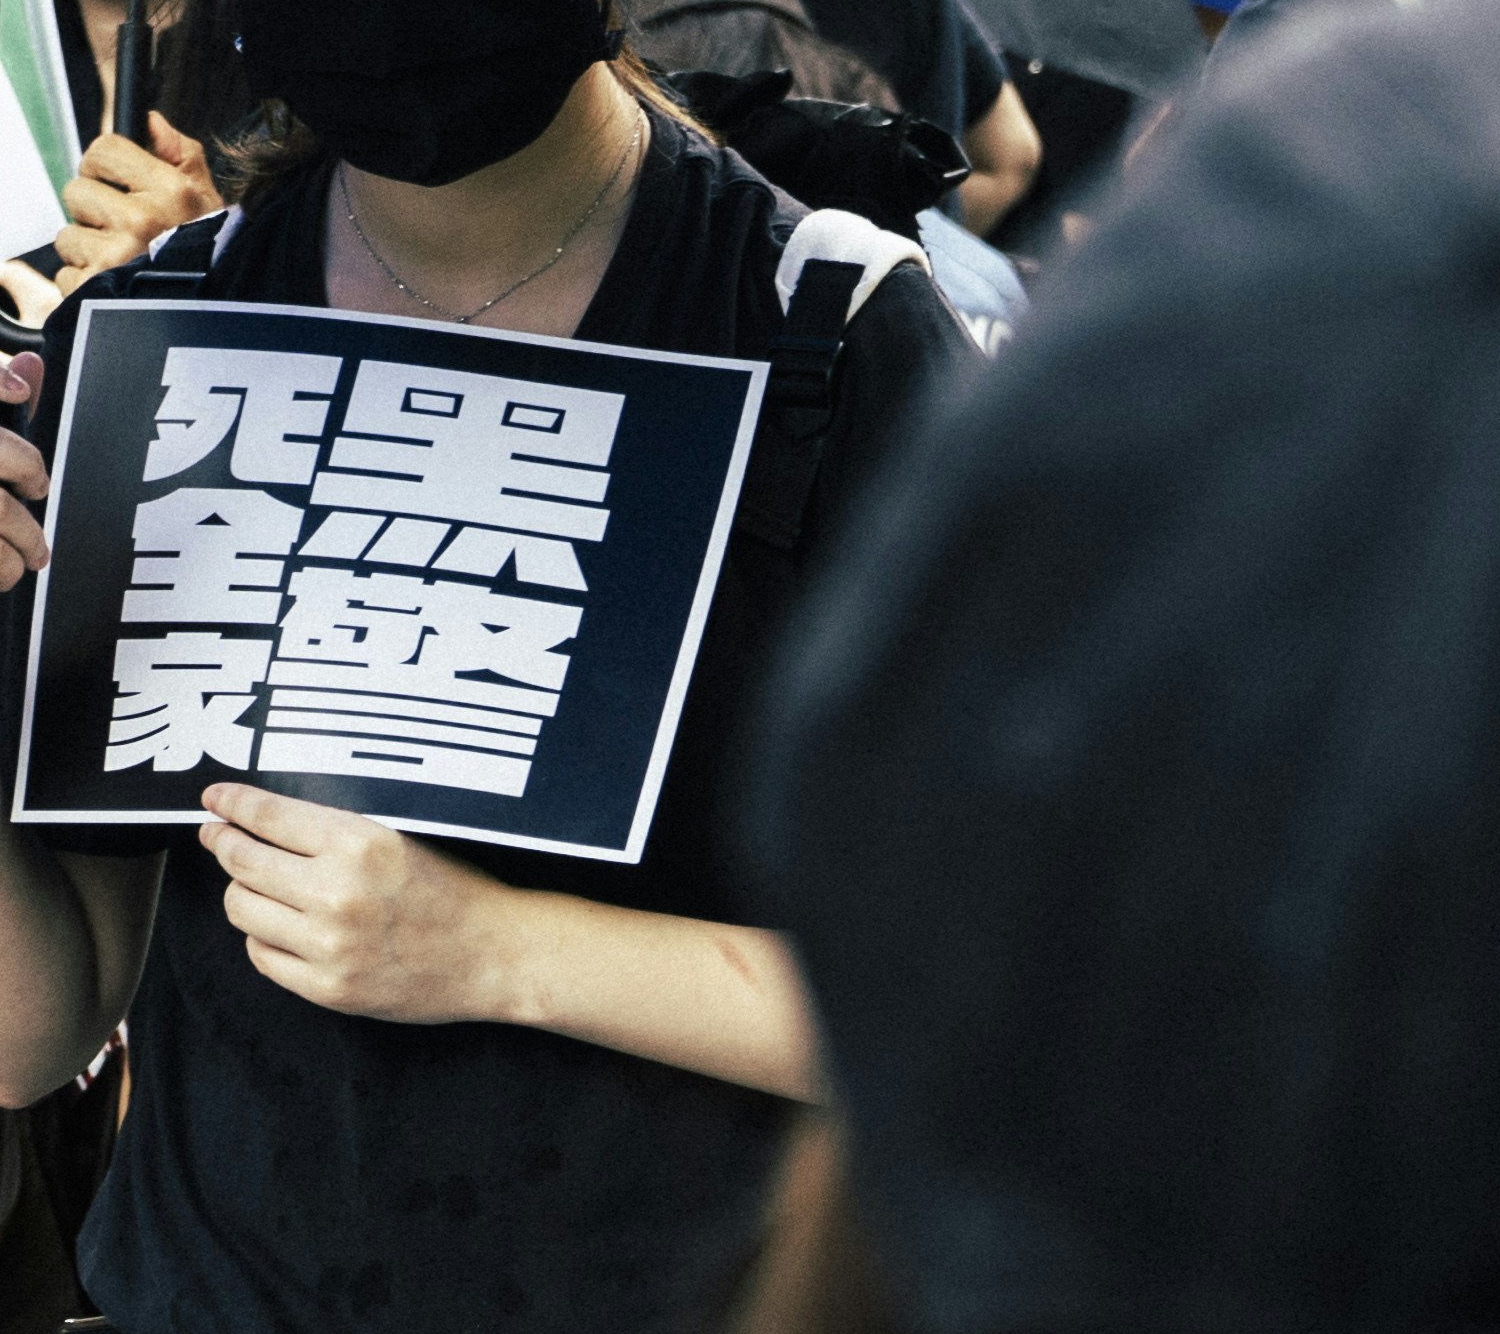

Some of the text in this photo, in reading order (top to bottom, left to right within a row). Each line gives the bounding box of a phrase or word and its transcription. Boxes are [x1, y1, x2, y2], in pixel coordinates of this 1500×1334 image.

[103, 346, 343, 771] 死全家
[257, 359, 626, 797] 黑警
